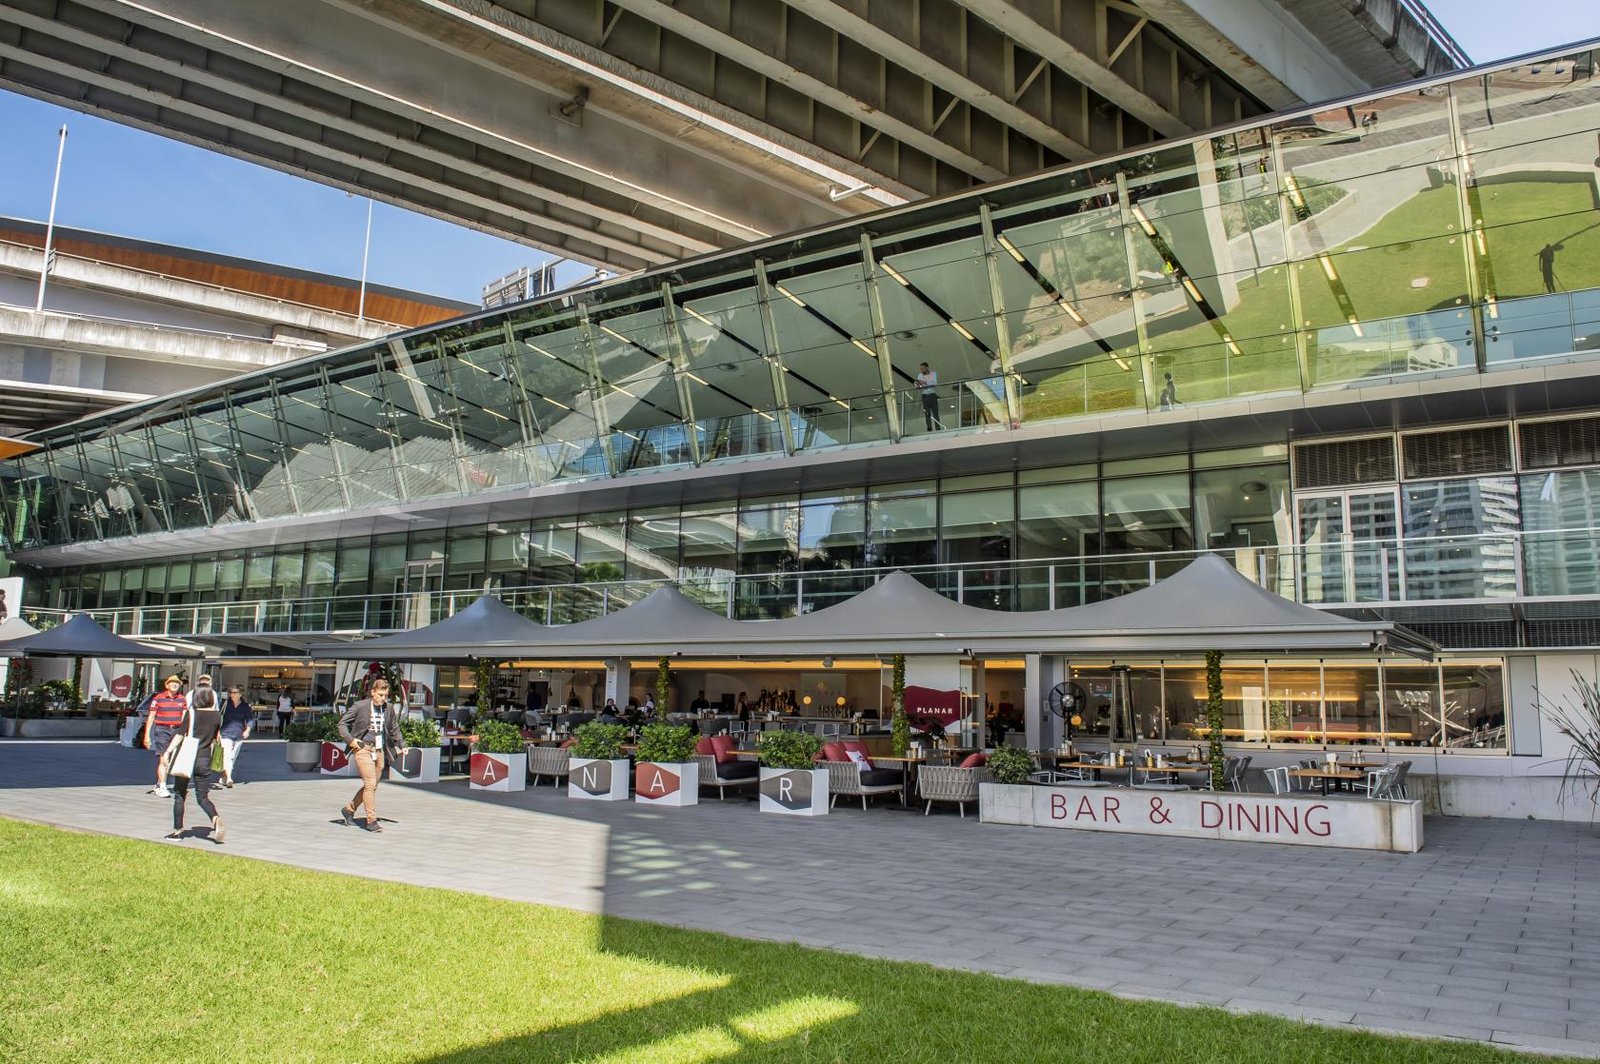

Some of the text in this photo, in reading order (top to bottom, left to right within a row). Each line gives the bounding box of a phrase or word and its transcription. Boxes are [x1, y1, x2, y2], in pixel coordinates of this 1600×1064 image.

[331, 749, 340, 766] P
[402, 751, 410, 772] L
[482, 760, 496, 781] A
[582, 766, 597, 789] N
[649, 770, 666, 793] A
[779, 777, 793, 802] R
[1051, 793, 1331, 837] BAR & DINING
